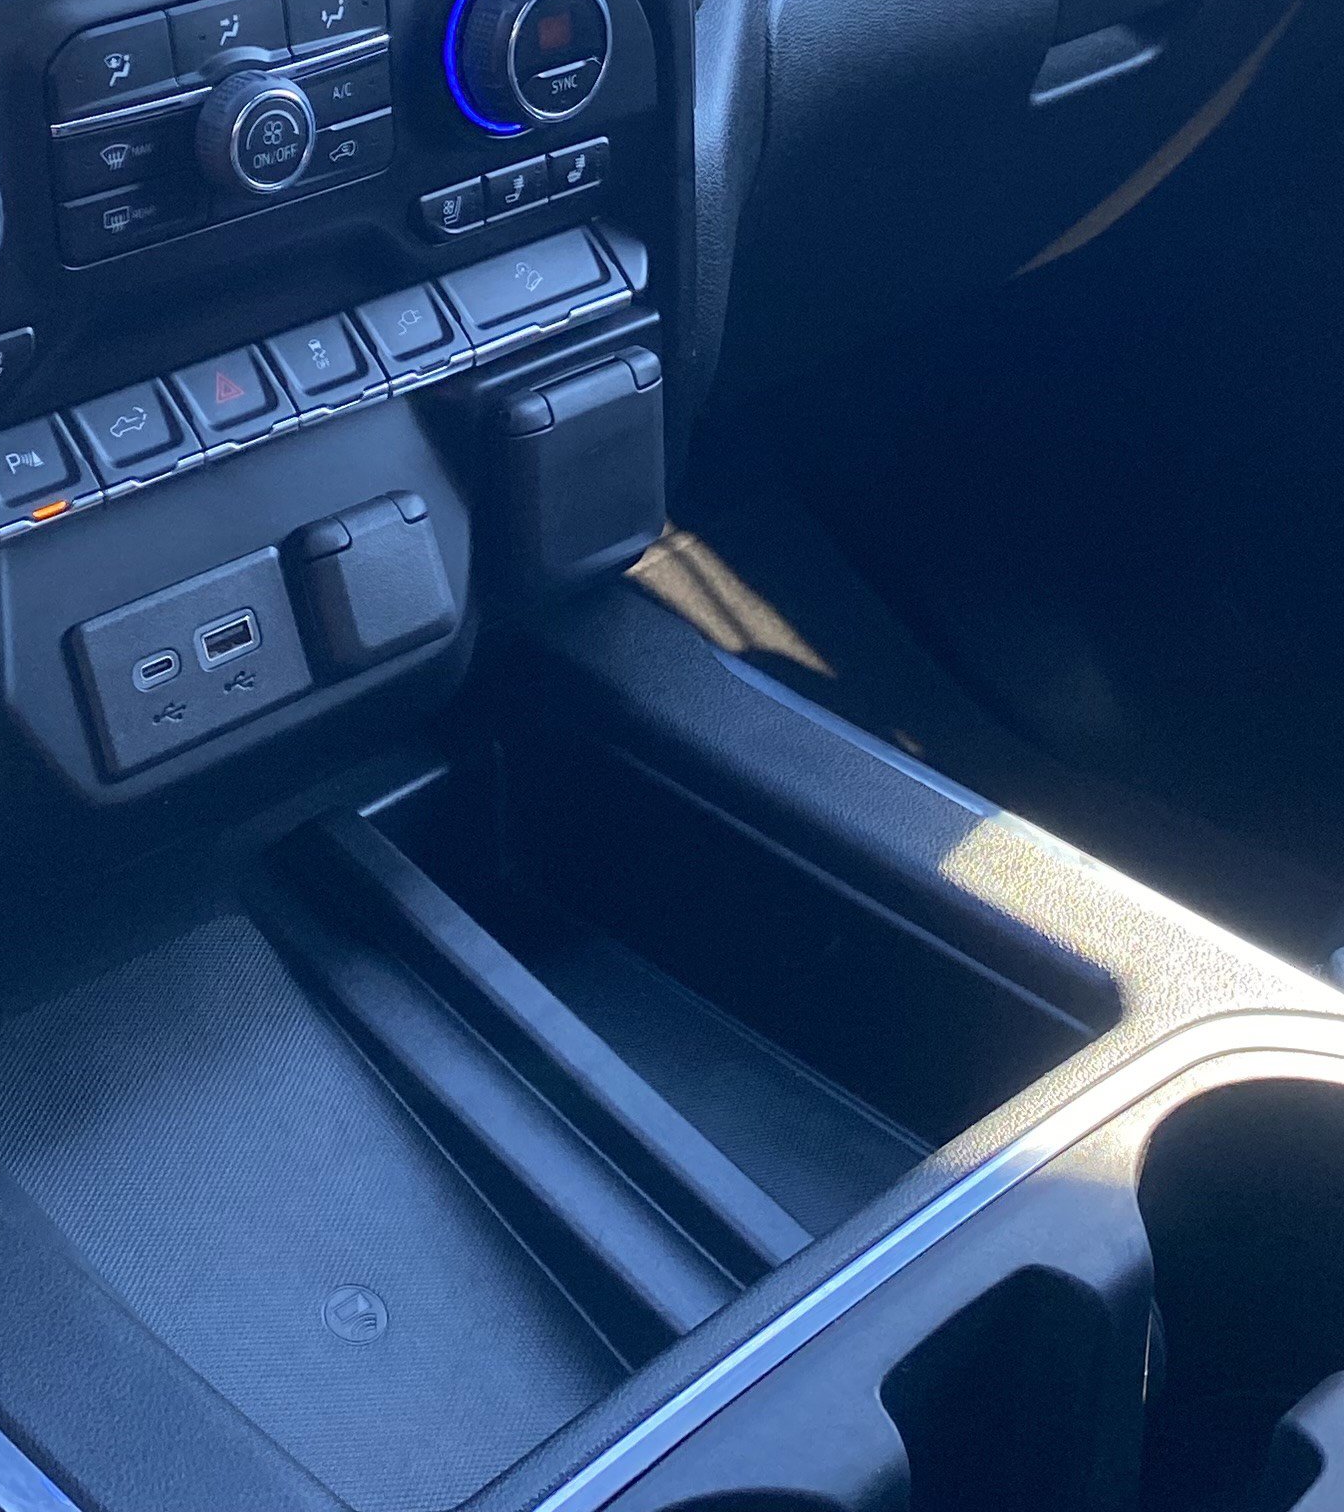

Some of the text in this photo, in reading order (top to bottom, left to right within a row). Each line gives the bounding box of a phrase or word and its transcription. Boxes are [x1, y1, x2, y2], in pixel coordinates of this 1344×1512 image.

[332, 82, 352, 100] A/C
[551, 74, 578, 95] SYNC
[253, 142, 298, 169] ON/OFF
